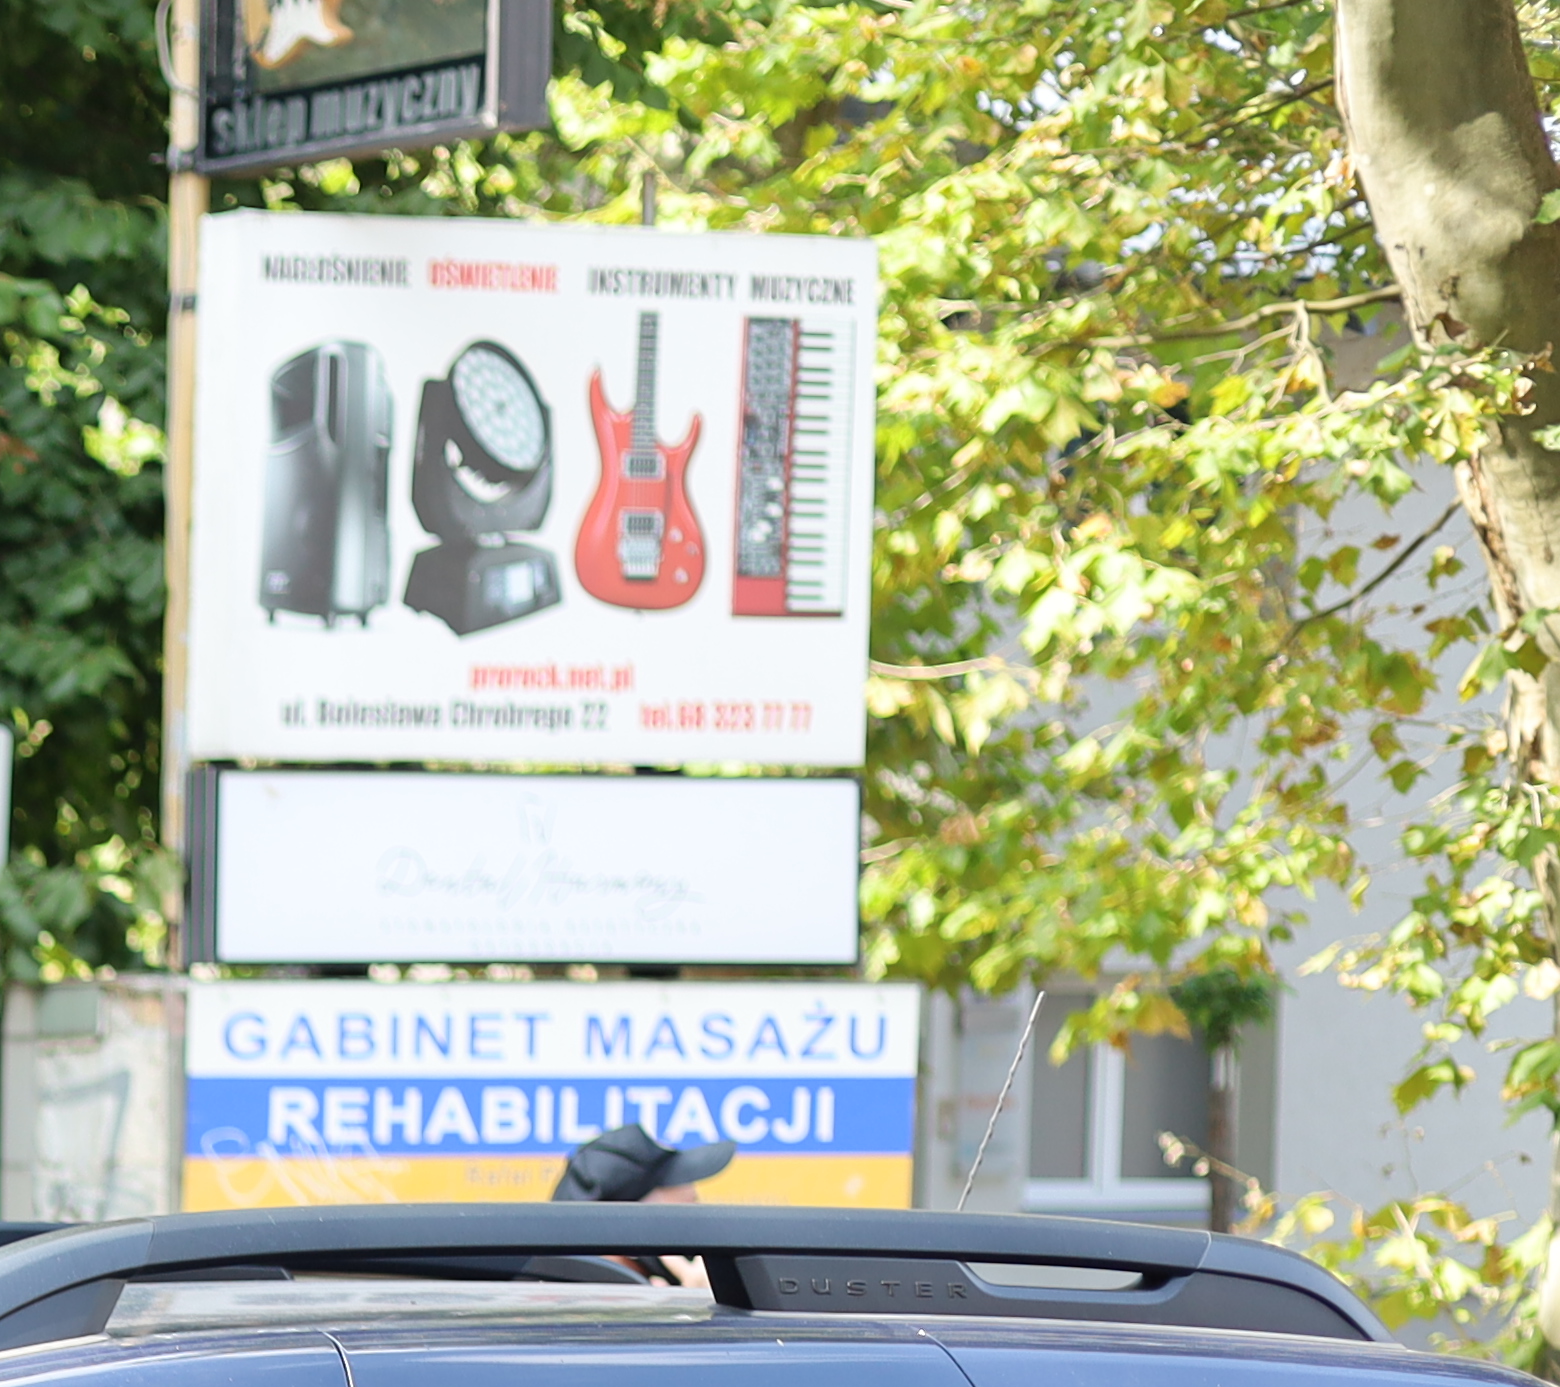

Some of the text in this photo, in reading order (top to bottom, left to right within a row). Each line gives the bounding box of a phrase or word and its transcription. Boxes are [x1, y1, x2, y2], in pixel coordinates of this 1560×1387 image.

[210, 63, 481, 154] sklep muzyczny
[750, 274, 855, 304] MUZYCZNE
[223, 1000, 887, 1060] GABINET MASAŻU
[268, 1085, 835, 1144] REHABILITACJI
[778, 1277, 968, 1299] DUSTER
